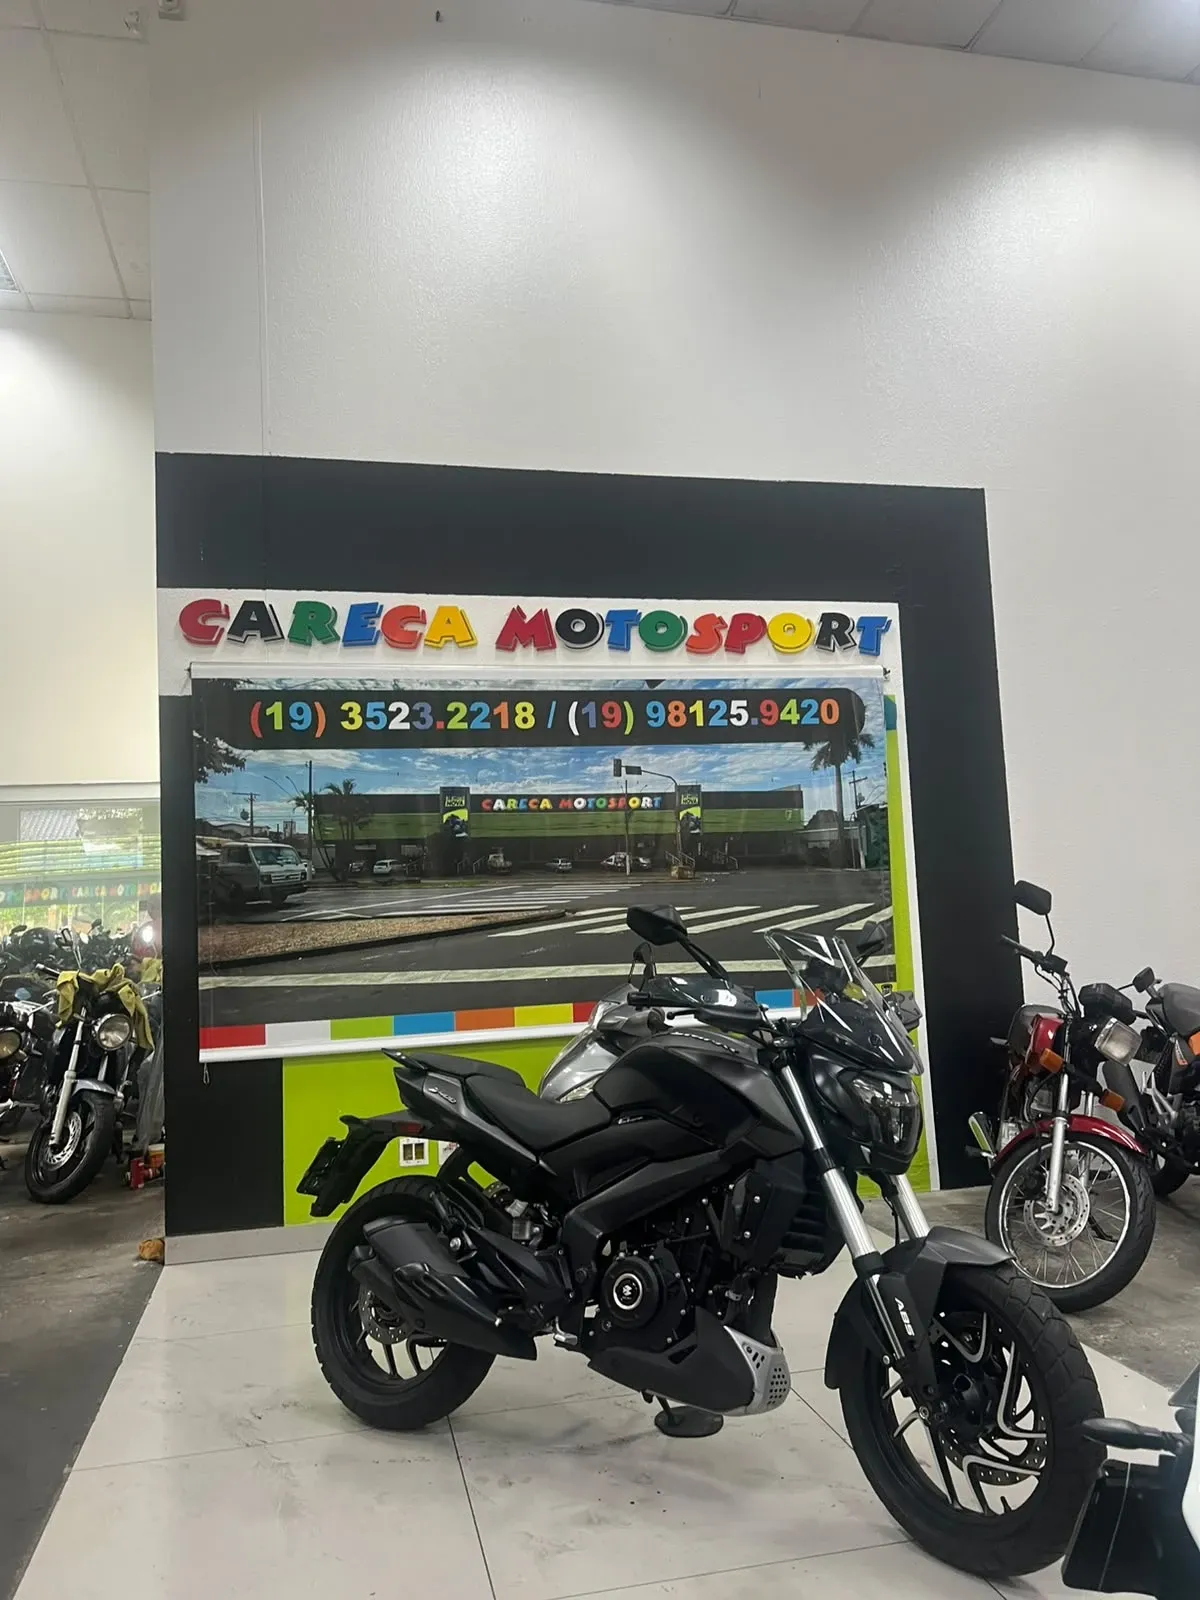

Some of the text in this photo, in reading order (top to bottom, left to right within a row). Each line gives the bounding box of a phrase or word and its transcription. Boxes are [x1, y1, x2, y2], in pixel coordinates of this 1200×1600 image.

[178, 598, 893, 657] CARECA MOTOSPORT
[250, 701, 326, 738] (19)
[340, 700, 536, 731] 3523.2218
[568, 701, 634, 736] (19)
[646, 699, 840, 729] 98125.9420
[481, 796, 663, 811] CARECA MOTOSPORT
[894, 1296, 915, 1336] ABS
